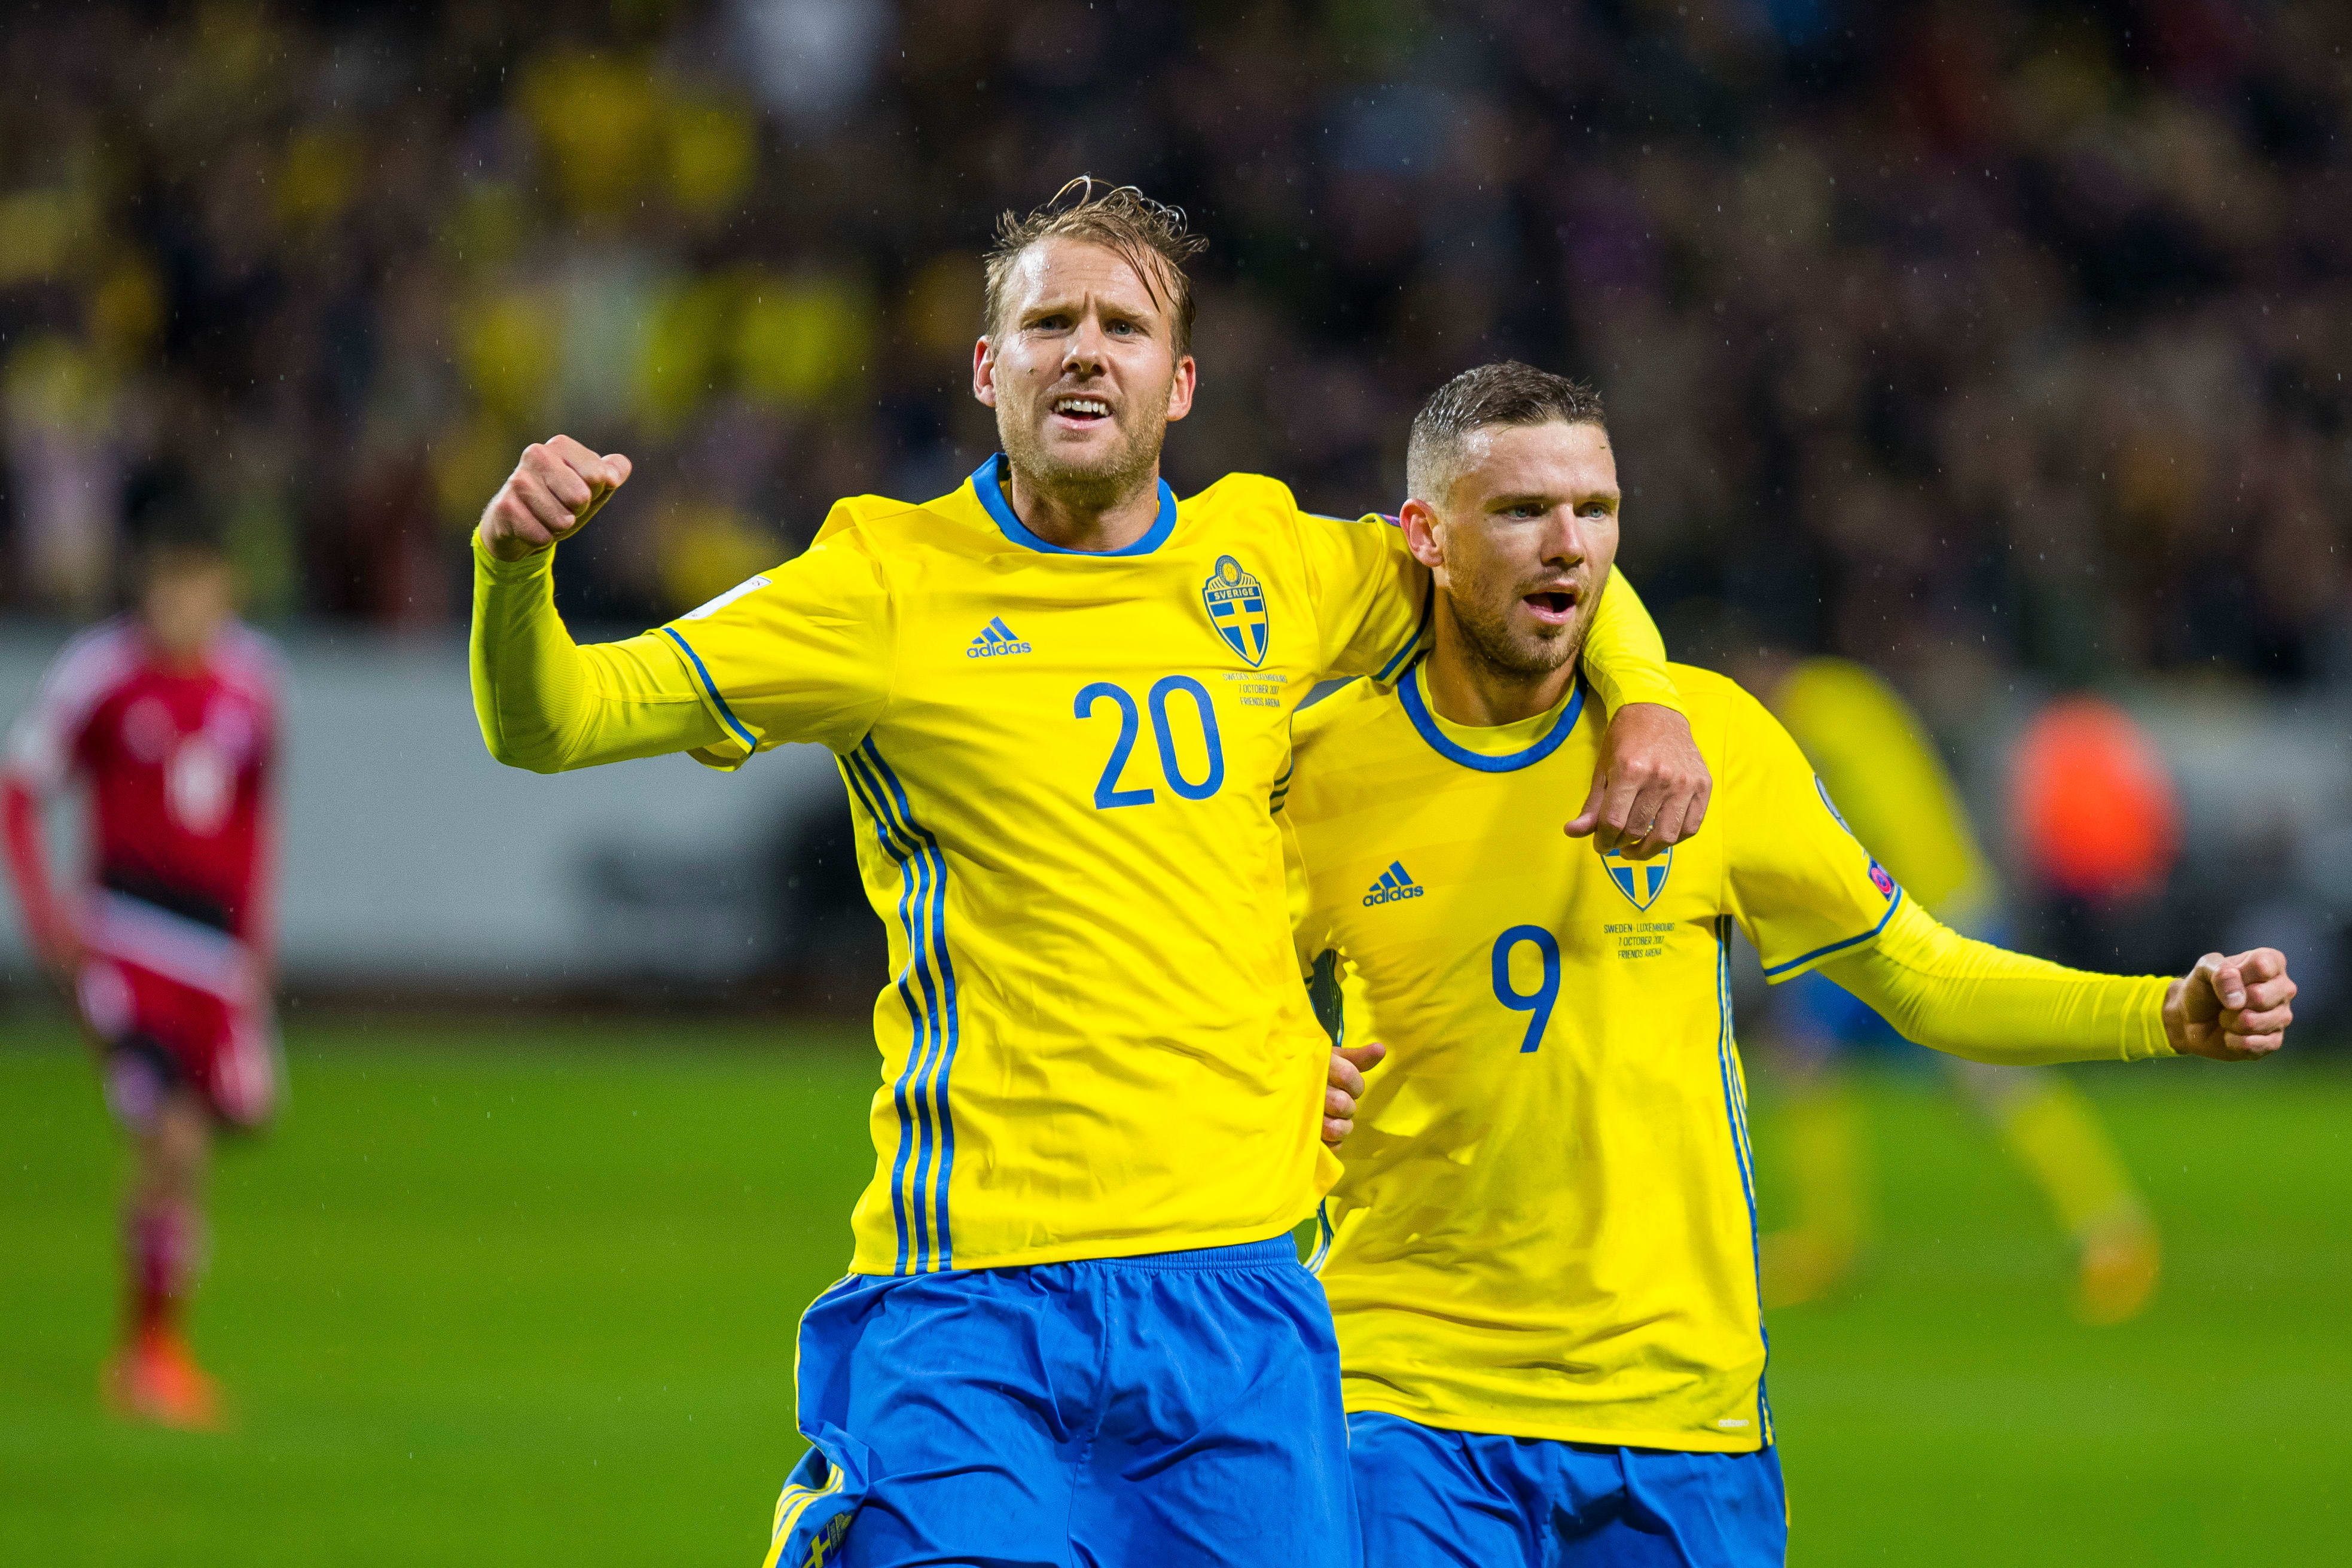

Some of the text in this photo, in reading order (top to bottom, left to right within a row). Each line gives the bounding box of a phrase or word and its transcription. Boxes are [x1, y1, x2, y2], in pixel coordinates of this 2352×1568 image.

[1214, 588, 1254, 600] SVERIGE
[966, 641, 1032, 658] adidas
[1243, 684, 1268, 694] OCTOBER
[1240, 697, 1280, 707] FRIENDS ARENA
[1073, 675, 1225, 810] 20
[1363, 886, 1424, 907] adidas
[1603, 923, 1633, 934] SWEDEN
[1636, 922, 1674, 932] LUXEMBOURG
[1623, 936, 1652, 946] OCTOBER
[1618, 947, 1661, 959] FRIENDS ARENA
[1491, 924, 1561, 1053] 9
